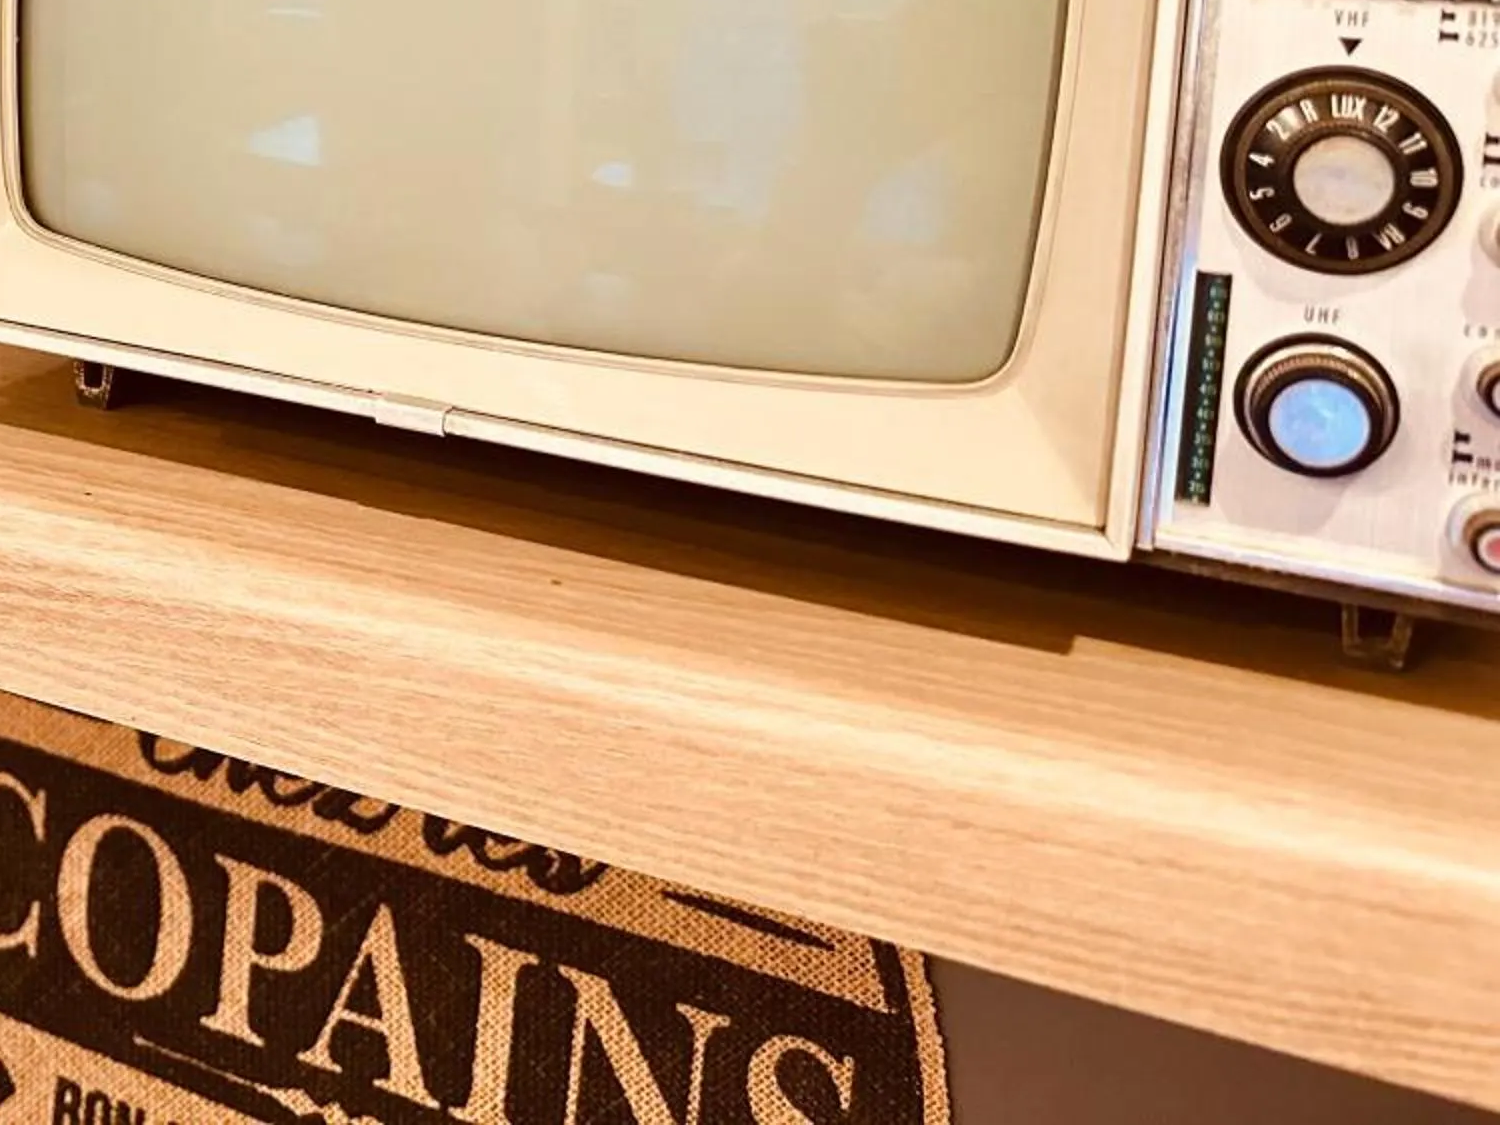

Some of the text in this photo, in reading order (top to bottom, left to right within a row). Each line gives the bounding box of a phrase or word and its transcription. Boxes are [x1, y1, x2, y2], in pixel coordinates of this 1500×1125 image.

[1334, 9, 1369, 27] VHF
[1331, 94, 1367, 120] LUX
[1373, 104, 1399, 133] 12
[1399, 131, 1428, 156] 11
[1248, 152, 1275, 168] 4
[1410, 169, 1439, 188] 10
[1249, 187, 1275, 202] 5
[1402, 201, 1429, 221] 9
[1304, 233, 1323, 256] 7
[1304, 304, 1340, 325] UHF
